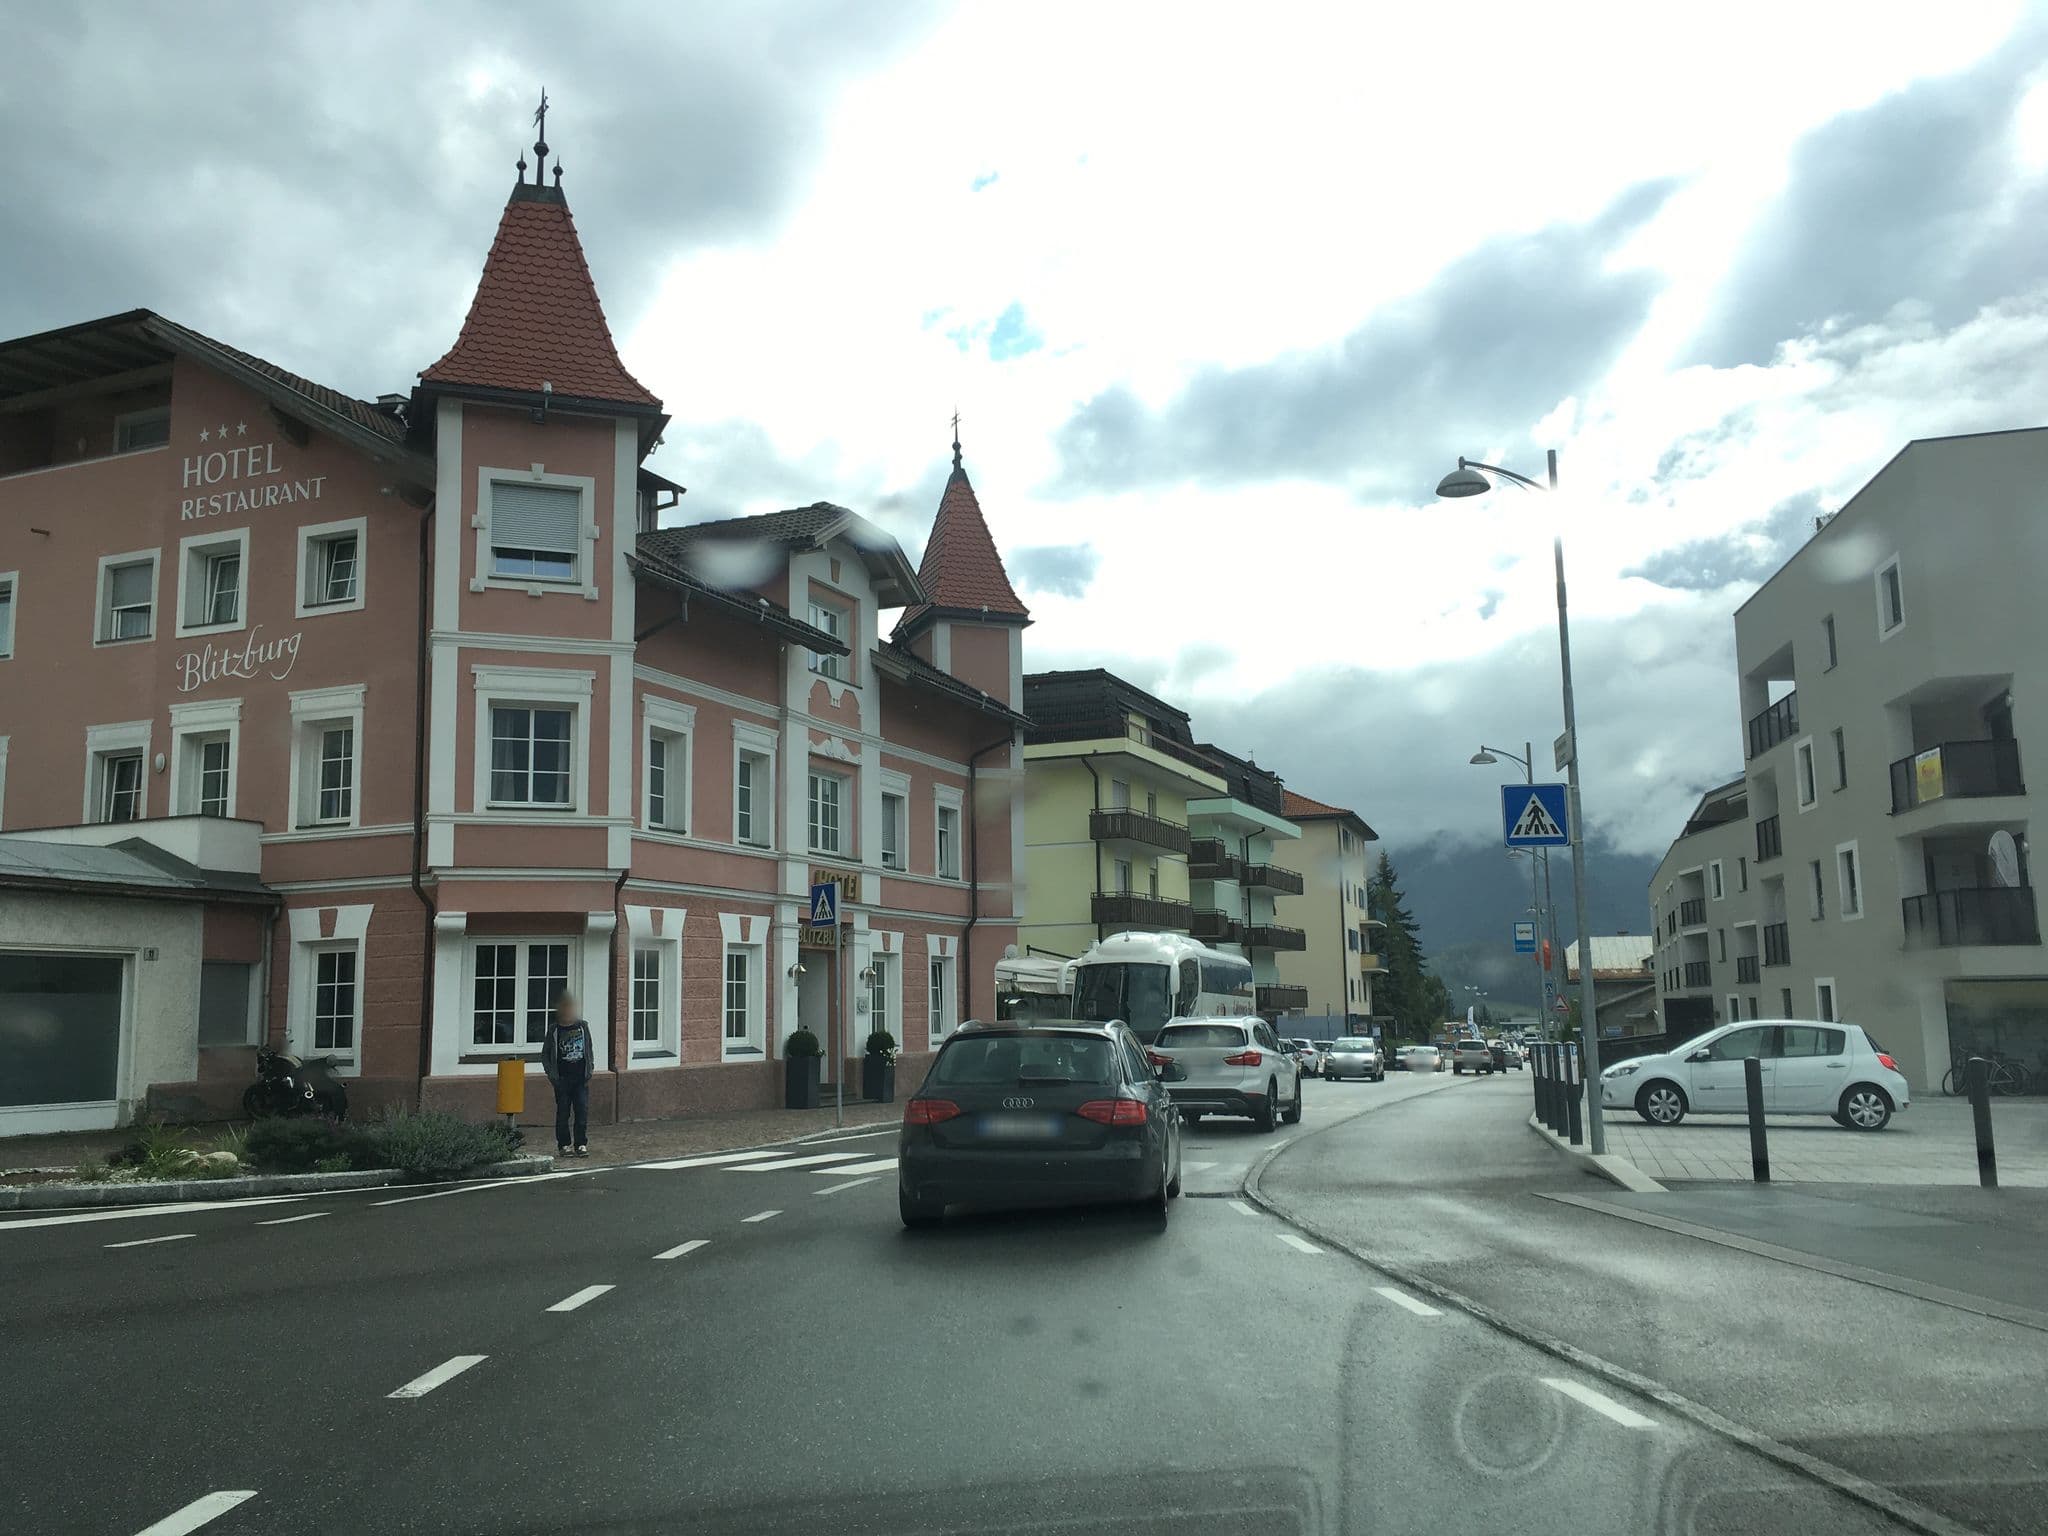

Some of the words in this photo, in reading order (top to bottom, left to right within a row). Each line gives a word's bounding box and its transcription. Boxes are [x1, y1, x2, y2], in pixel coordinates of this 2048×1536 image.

[183, 443, 281, 488] HOTEL
[181, 476, 327, 520] RESTAURANT
[176, 624, 302, 692] Blitzburg
